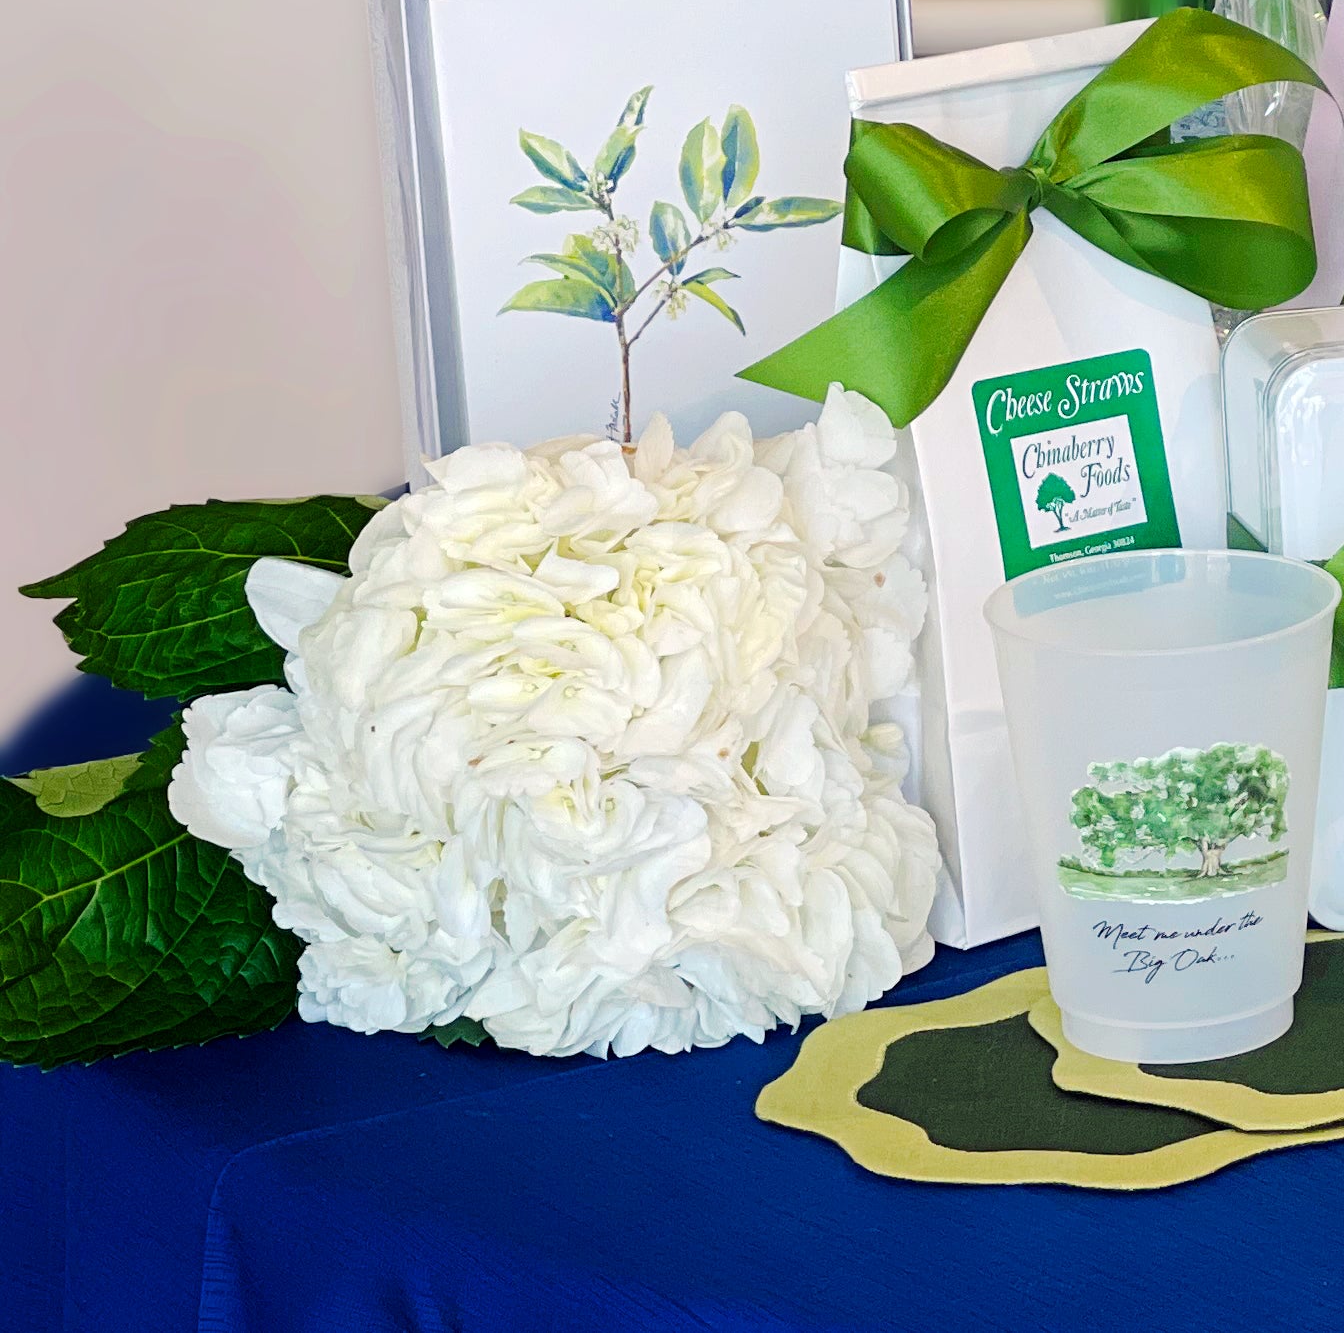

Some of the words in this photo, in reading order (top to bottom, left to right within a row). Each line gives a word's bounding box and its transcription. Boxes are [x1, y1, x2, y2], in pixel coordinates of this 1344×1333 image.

[986, 387, 1052, 437] Cheese
[1057, 371, 1145, 419] Straws
[1022, 434, 1115, 479] Chinaberry
[1080, 457, 1131, 498] Foods
[1092, 920, 1150, 950] Meet
[1153, 931, 1181, 941] me
[1183, 917, 1237, 939] under
[1237, 910, 1264, 928] the
[1111, 950, 1168, 985] Big
[1174, 946, 1235, 972] Oak...
